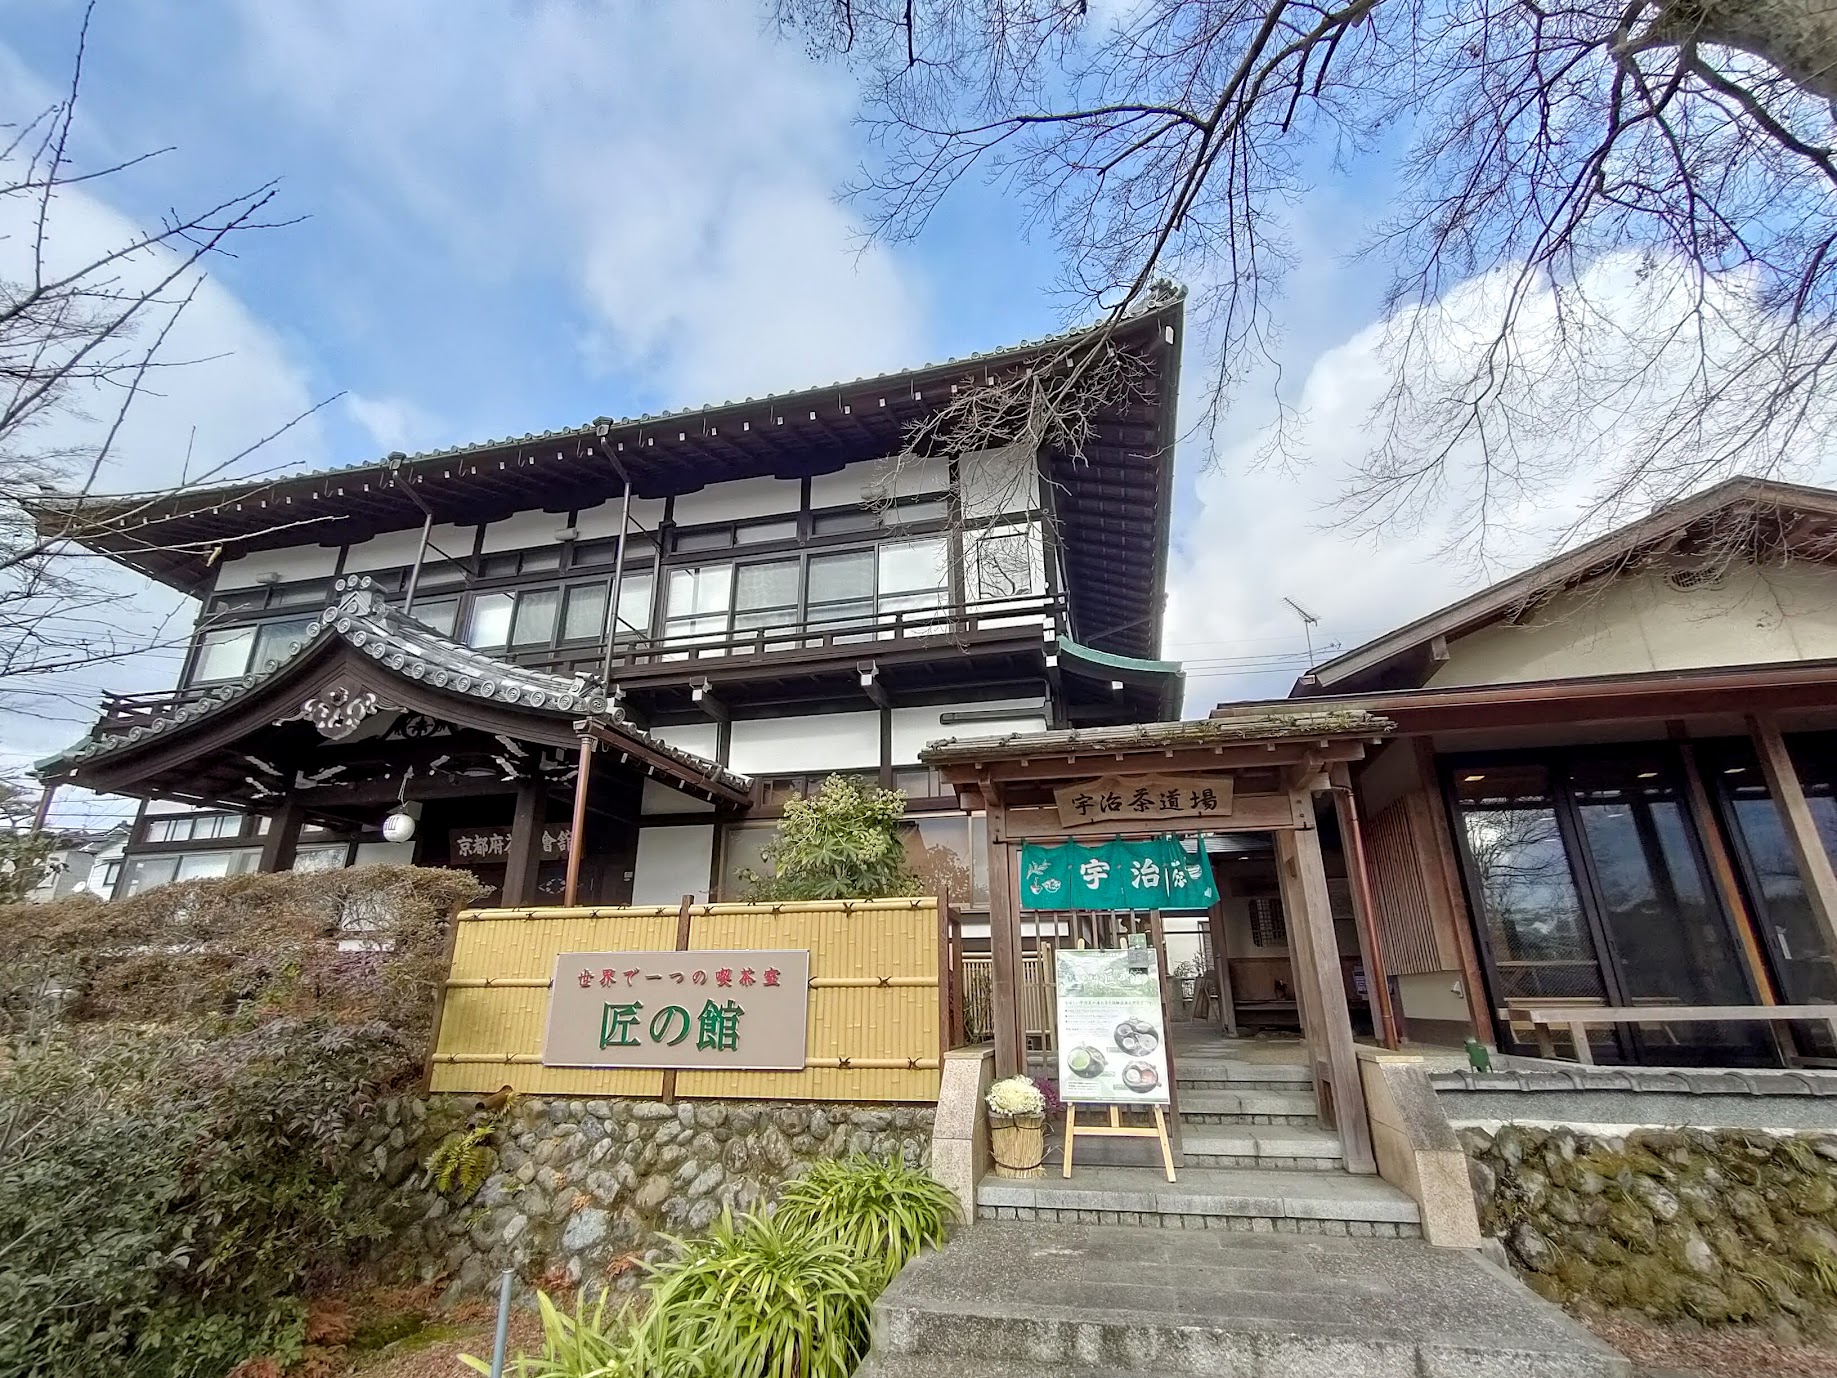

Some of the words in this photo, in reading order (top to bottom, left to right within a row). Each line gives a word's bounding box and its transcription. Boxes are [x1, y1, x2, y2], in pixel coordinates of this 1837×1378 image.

[1071, 788, 1219, 816] 宇治茶道場
[577, 966, 782, 988] 世界で一つの喫茶室
[599, 998, 746, 1052] 匠の館
